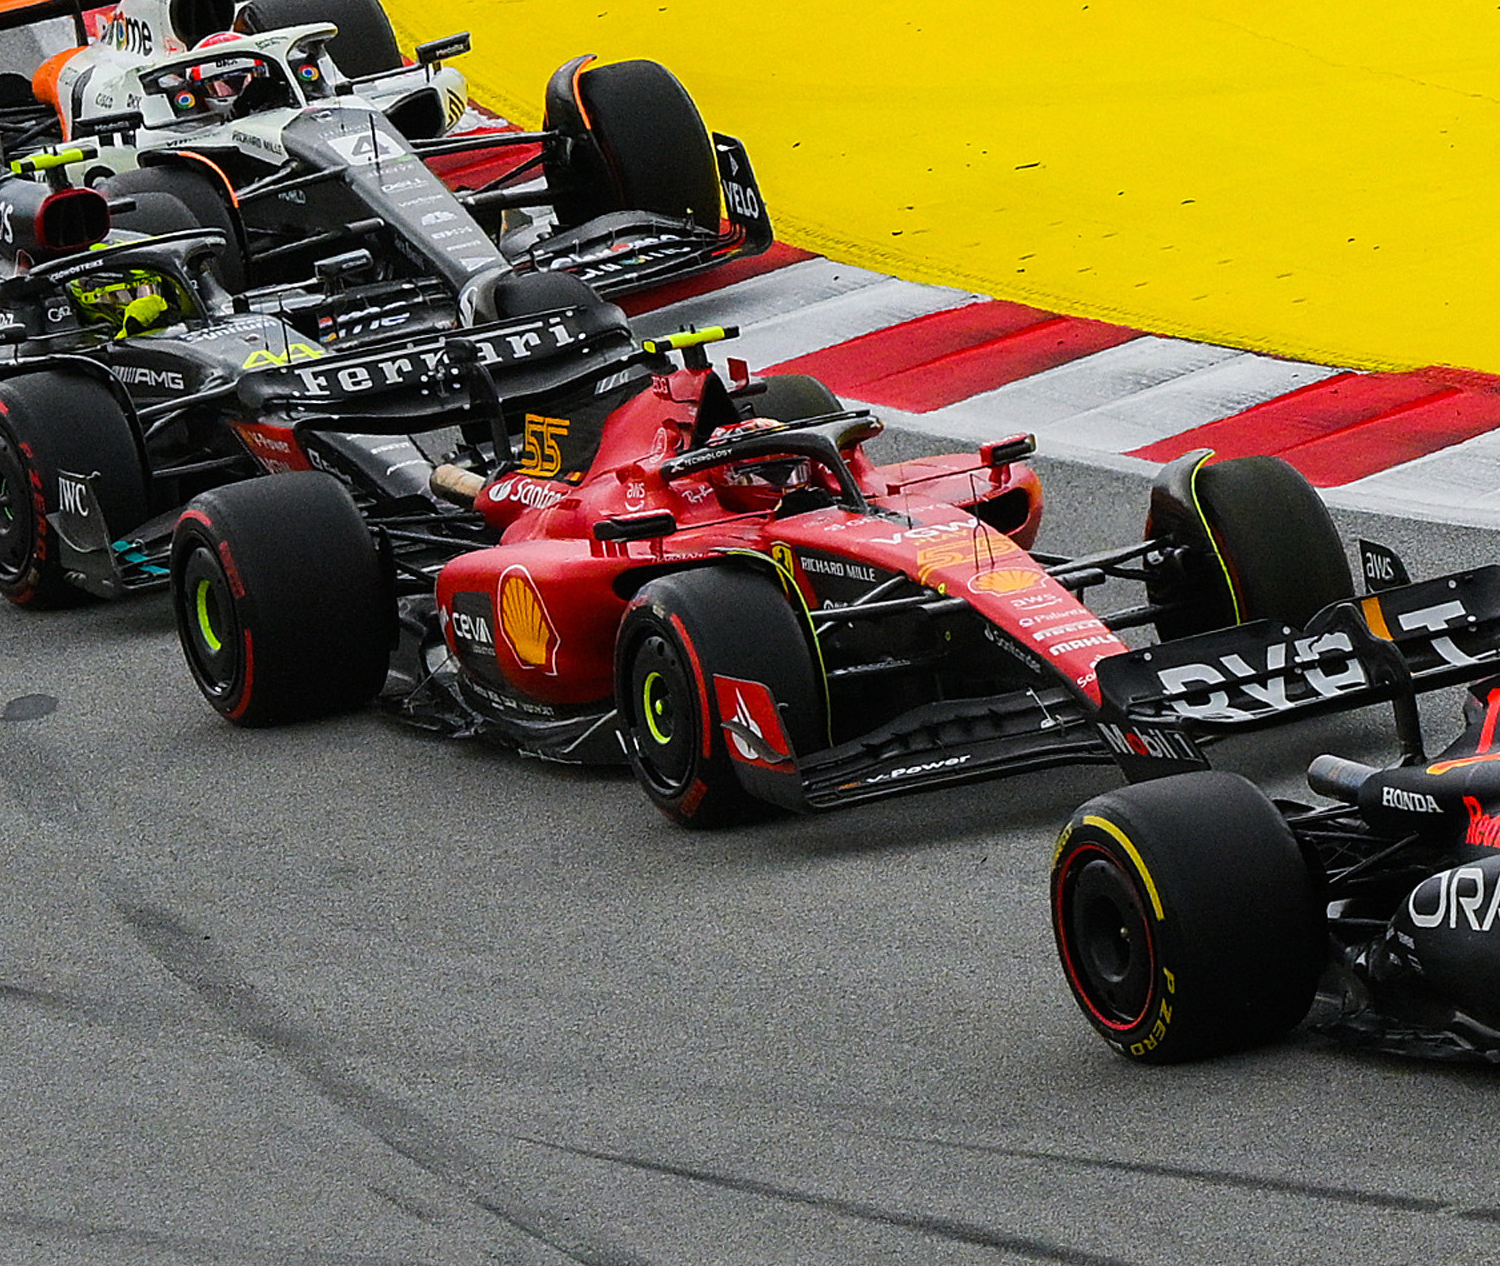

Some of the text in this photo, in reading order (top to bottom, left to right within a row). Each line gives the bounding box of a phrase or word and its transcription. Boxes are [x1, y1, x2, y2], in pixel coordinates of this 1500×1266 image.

[722, 178, 759, 220] VELO
[519, 412, 571, 478] 55
[58, 475, 89, 518] IWC
[626, 481, 646, 498] aws
[800, 556, 878, 583] RICHARD MILLE
[1365, 551, 1395, 581] aws
[1097, 722, 1180, 760] Mobil
[1381, 786, 1444, 814] HONDA
[1130, 997, 1173, 1056] ZERO
